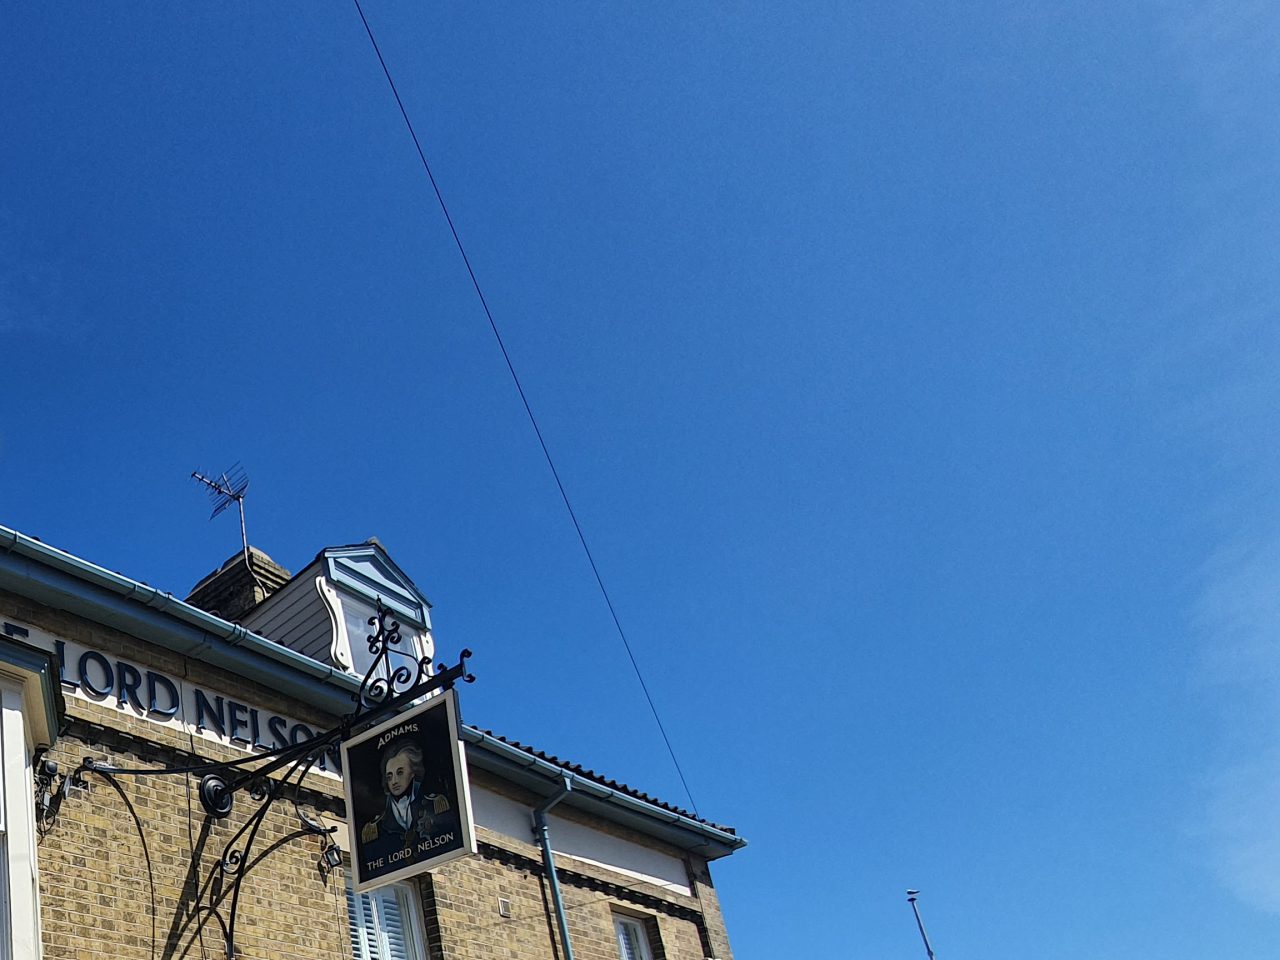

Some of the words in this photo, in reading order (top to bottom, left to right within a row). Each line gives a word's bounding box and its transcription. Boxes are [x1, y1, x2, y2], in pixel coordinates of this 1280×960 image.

[55, 639, 180, 717] LORD
[377, 723, 419, 749] ADNAMS
[367, 857, 384, 871] THE
[388, 848, 412, 863] LORD
[418, 832, 454, 853] NELSON
